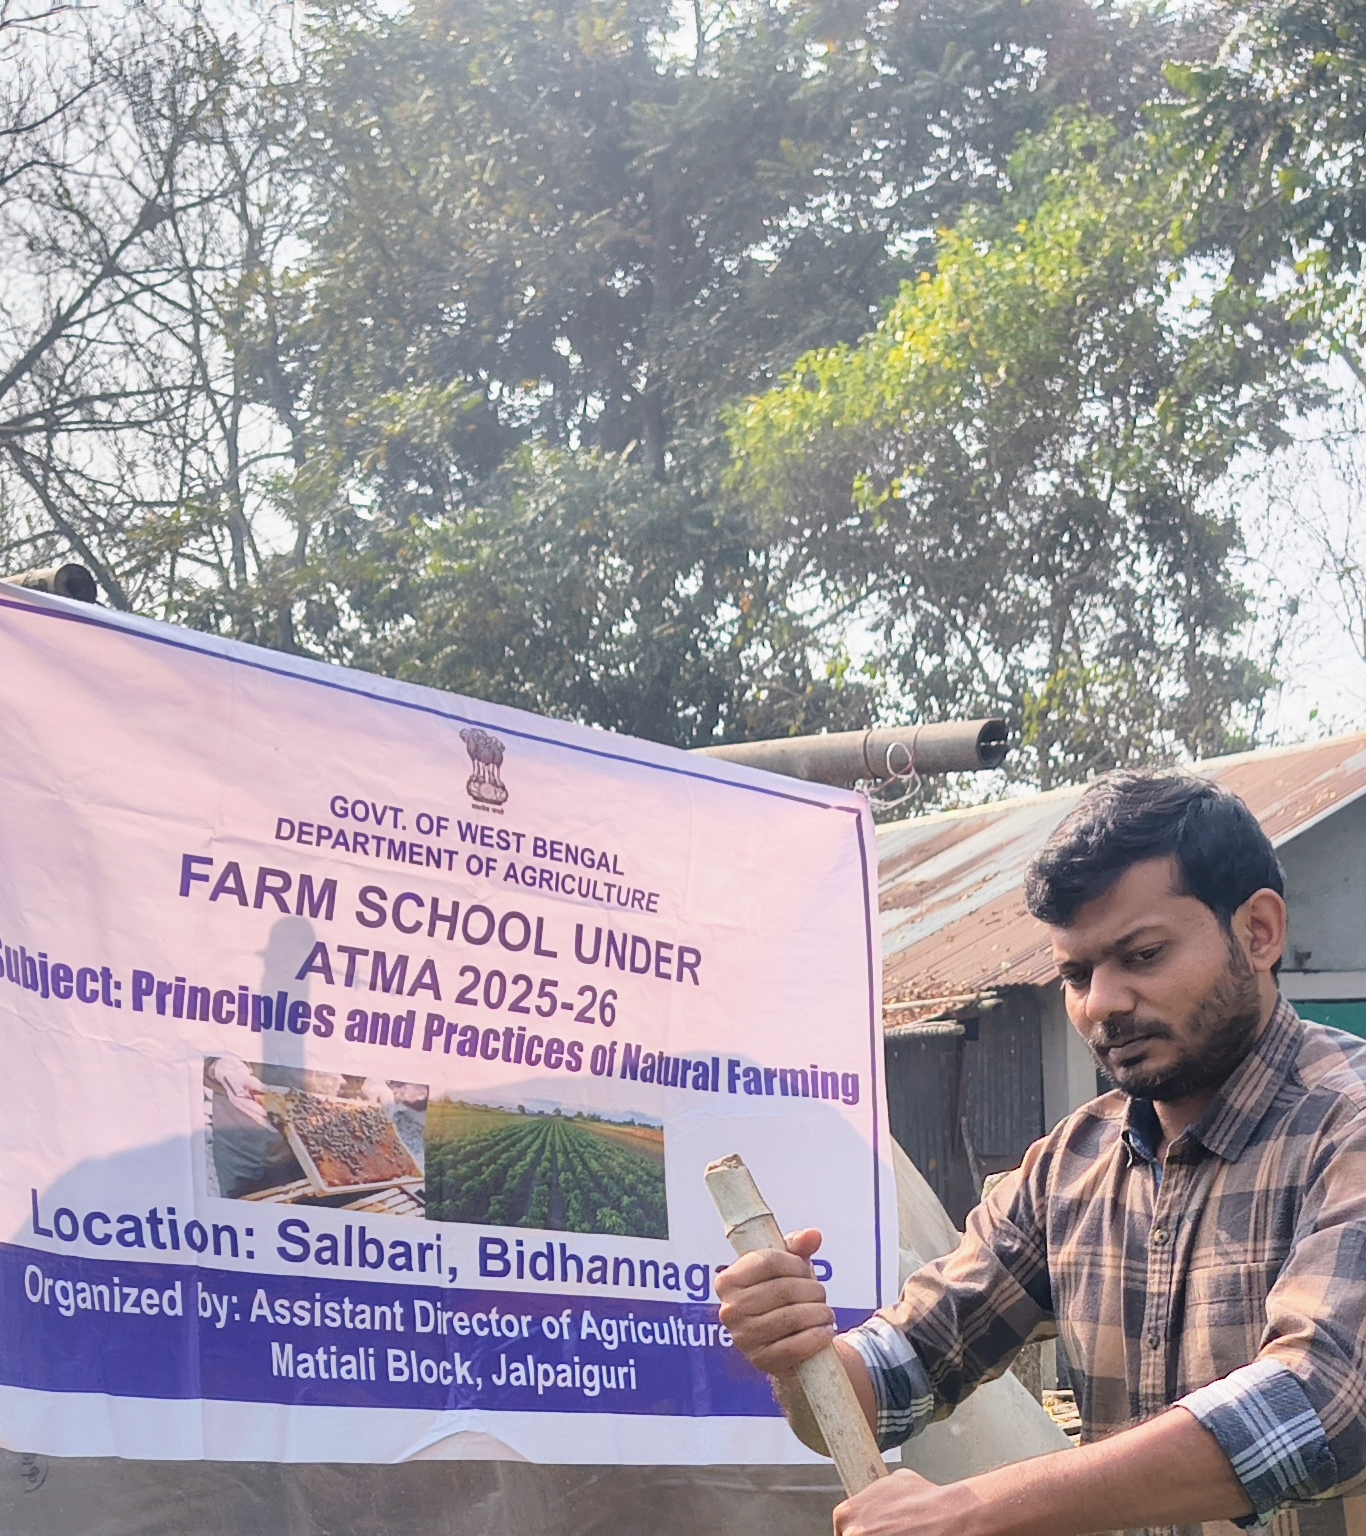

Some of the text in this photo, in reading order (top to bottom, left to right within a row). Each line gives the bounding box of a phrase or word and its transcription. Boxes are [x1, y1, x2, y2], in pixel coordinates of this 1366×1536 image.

[274, 817, 661, 914] DEPARTMENT OF AGRICULTURE
[330, 795, 625, 876] GOVT. OF WEST BENGAL
[178, 853, 702, 986] FARM SCHOOL UNDER
[294, 941, 618, 1028] ATMA 2025-26
[131, 969, 335, 1038] Principles
[344, 1004, 416, 1050] and
[423, 1011, 583, 1073] Practices
[589, 1041, 618, 1077] of
[620, 1043, 720, 1093] Natural
[728, 1058, 860, 1106] Farming
[31, 1188, 255, 1259] Location:
[276, 1218, 459, 1284] Salbari,
[478, 1235, 729, 1302] Bidhannag
[24, 1264, 183, 1316] Organized
[198, 1281, 240, 1329] by:
[250, 1289, 404, 1333] Assistant
[415, 1300, 531, 1339] Director
[541, 1308, 571, 1341] of
[271, 1341, 637, 1397] Matiali Block, Jalpaiguri
